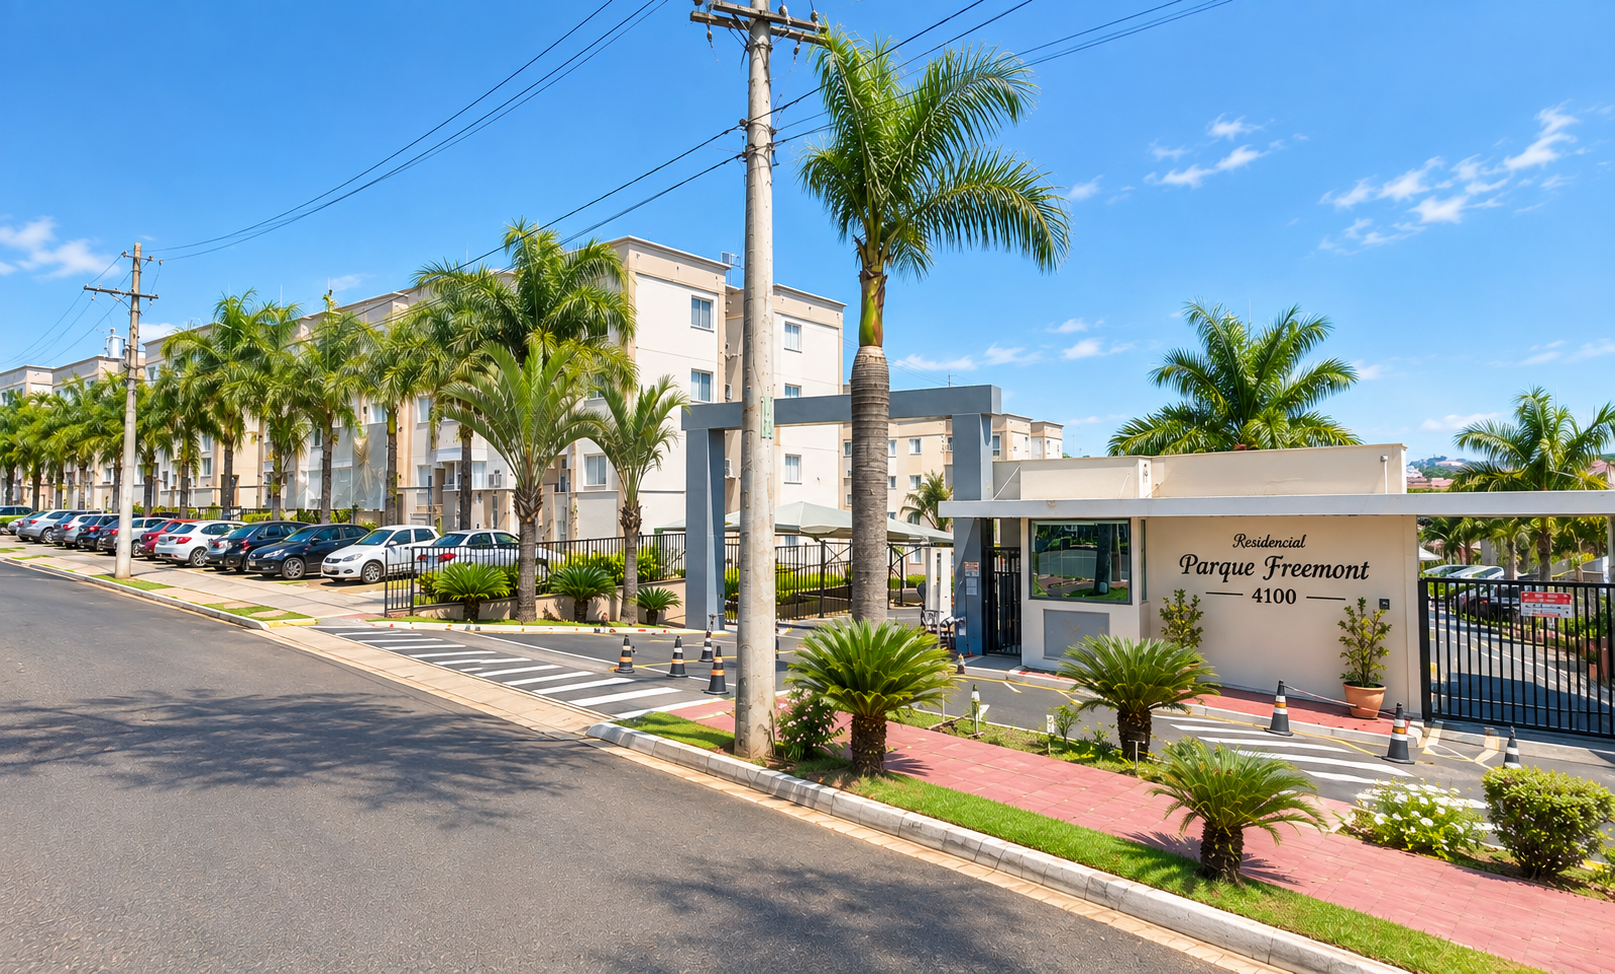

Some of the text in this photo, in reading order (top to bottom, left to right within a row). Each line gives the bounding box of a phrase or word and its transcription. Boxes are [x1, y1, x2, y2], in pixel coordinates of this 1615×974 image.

[1232, 533, 1307, 549] Residencial
[1179, 553, 1370, 583] Parque Freemont
[1251, 587, 1297, 605] 4100
